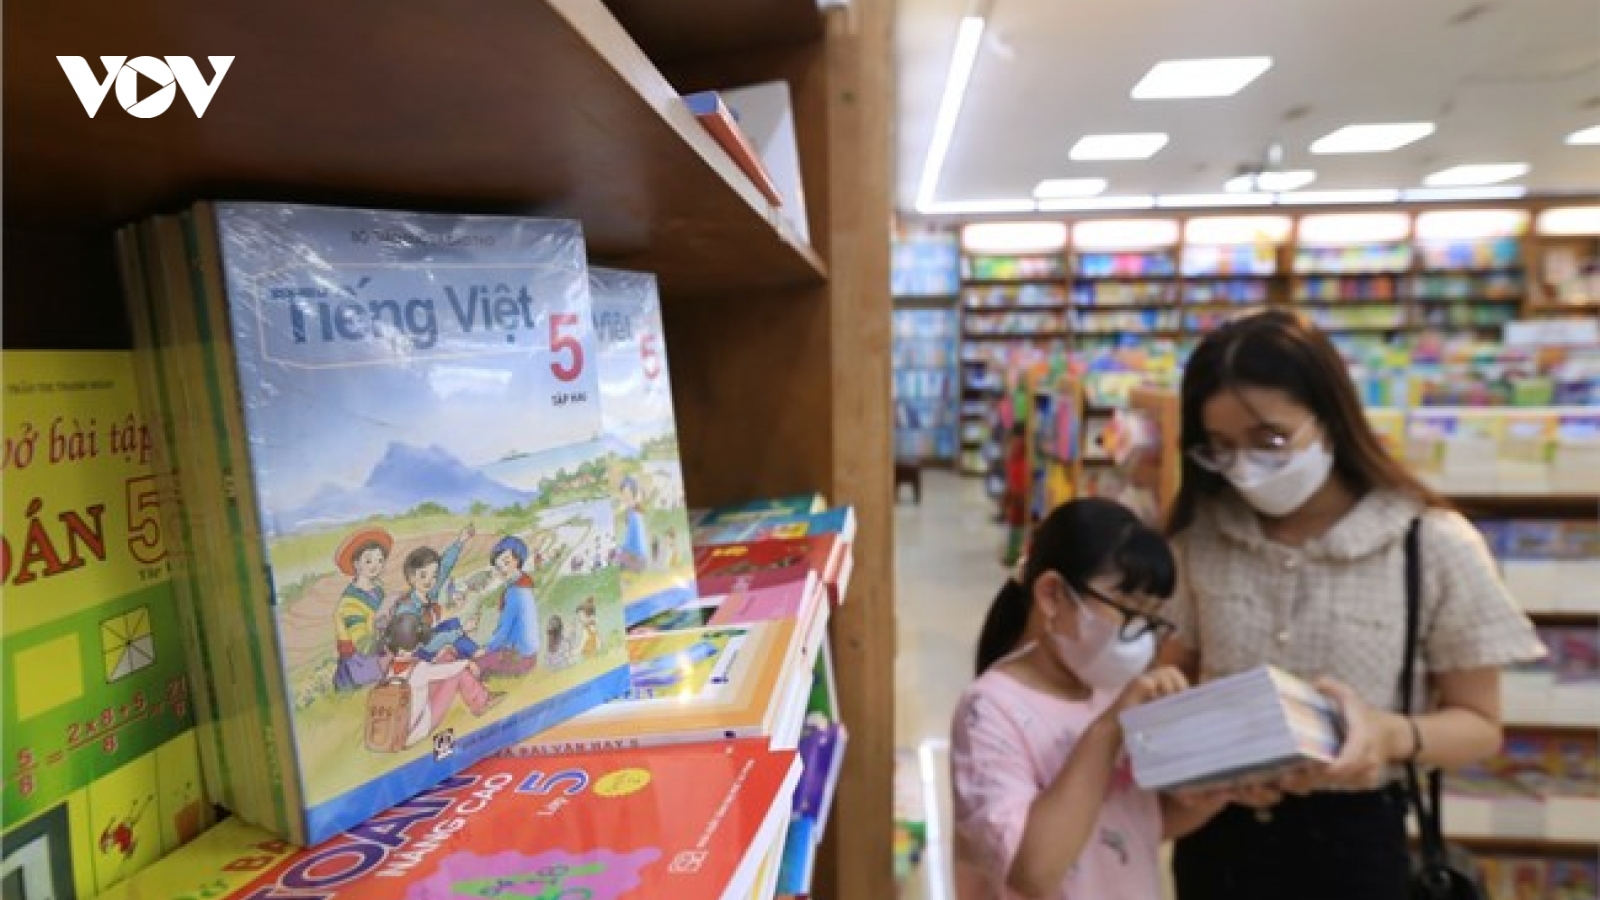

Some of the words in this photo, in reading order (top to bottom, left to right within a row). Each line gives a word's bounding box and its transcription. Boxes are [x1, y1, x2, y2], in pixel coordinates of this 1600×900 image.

[270, 276, 438, 350] Tiếng
[444, 282, 535, 343] Việt
[548, 312, 584, 382] 5
[640, 332, 661, 381] 5
[49, 415, 98, 463] bài
[0, 496, 107, 586] ÁN
[125, 474, 169, 564] 5
[455, 773, 513, 814] CAO
[514, 769, 589, 796] 5
